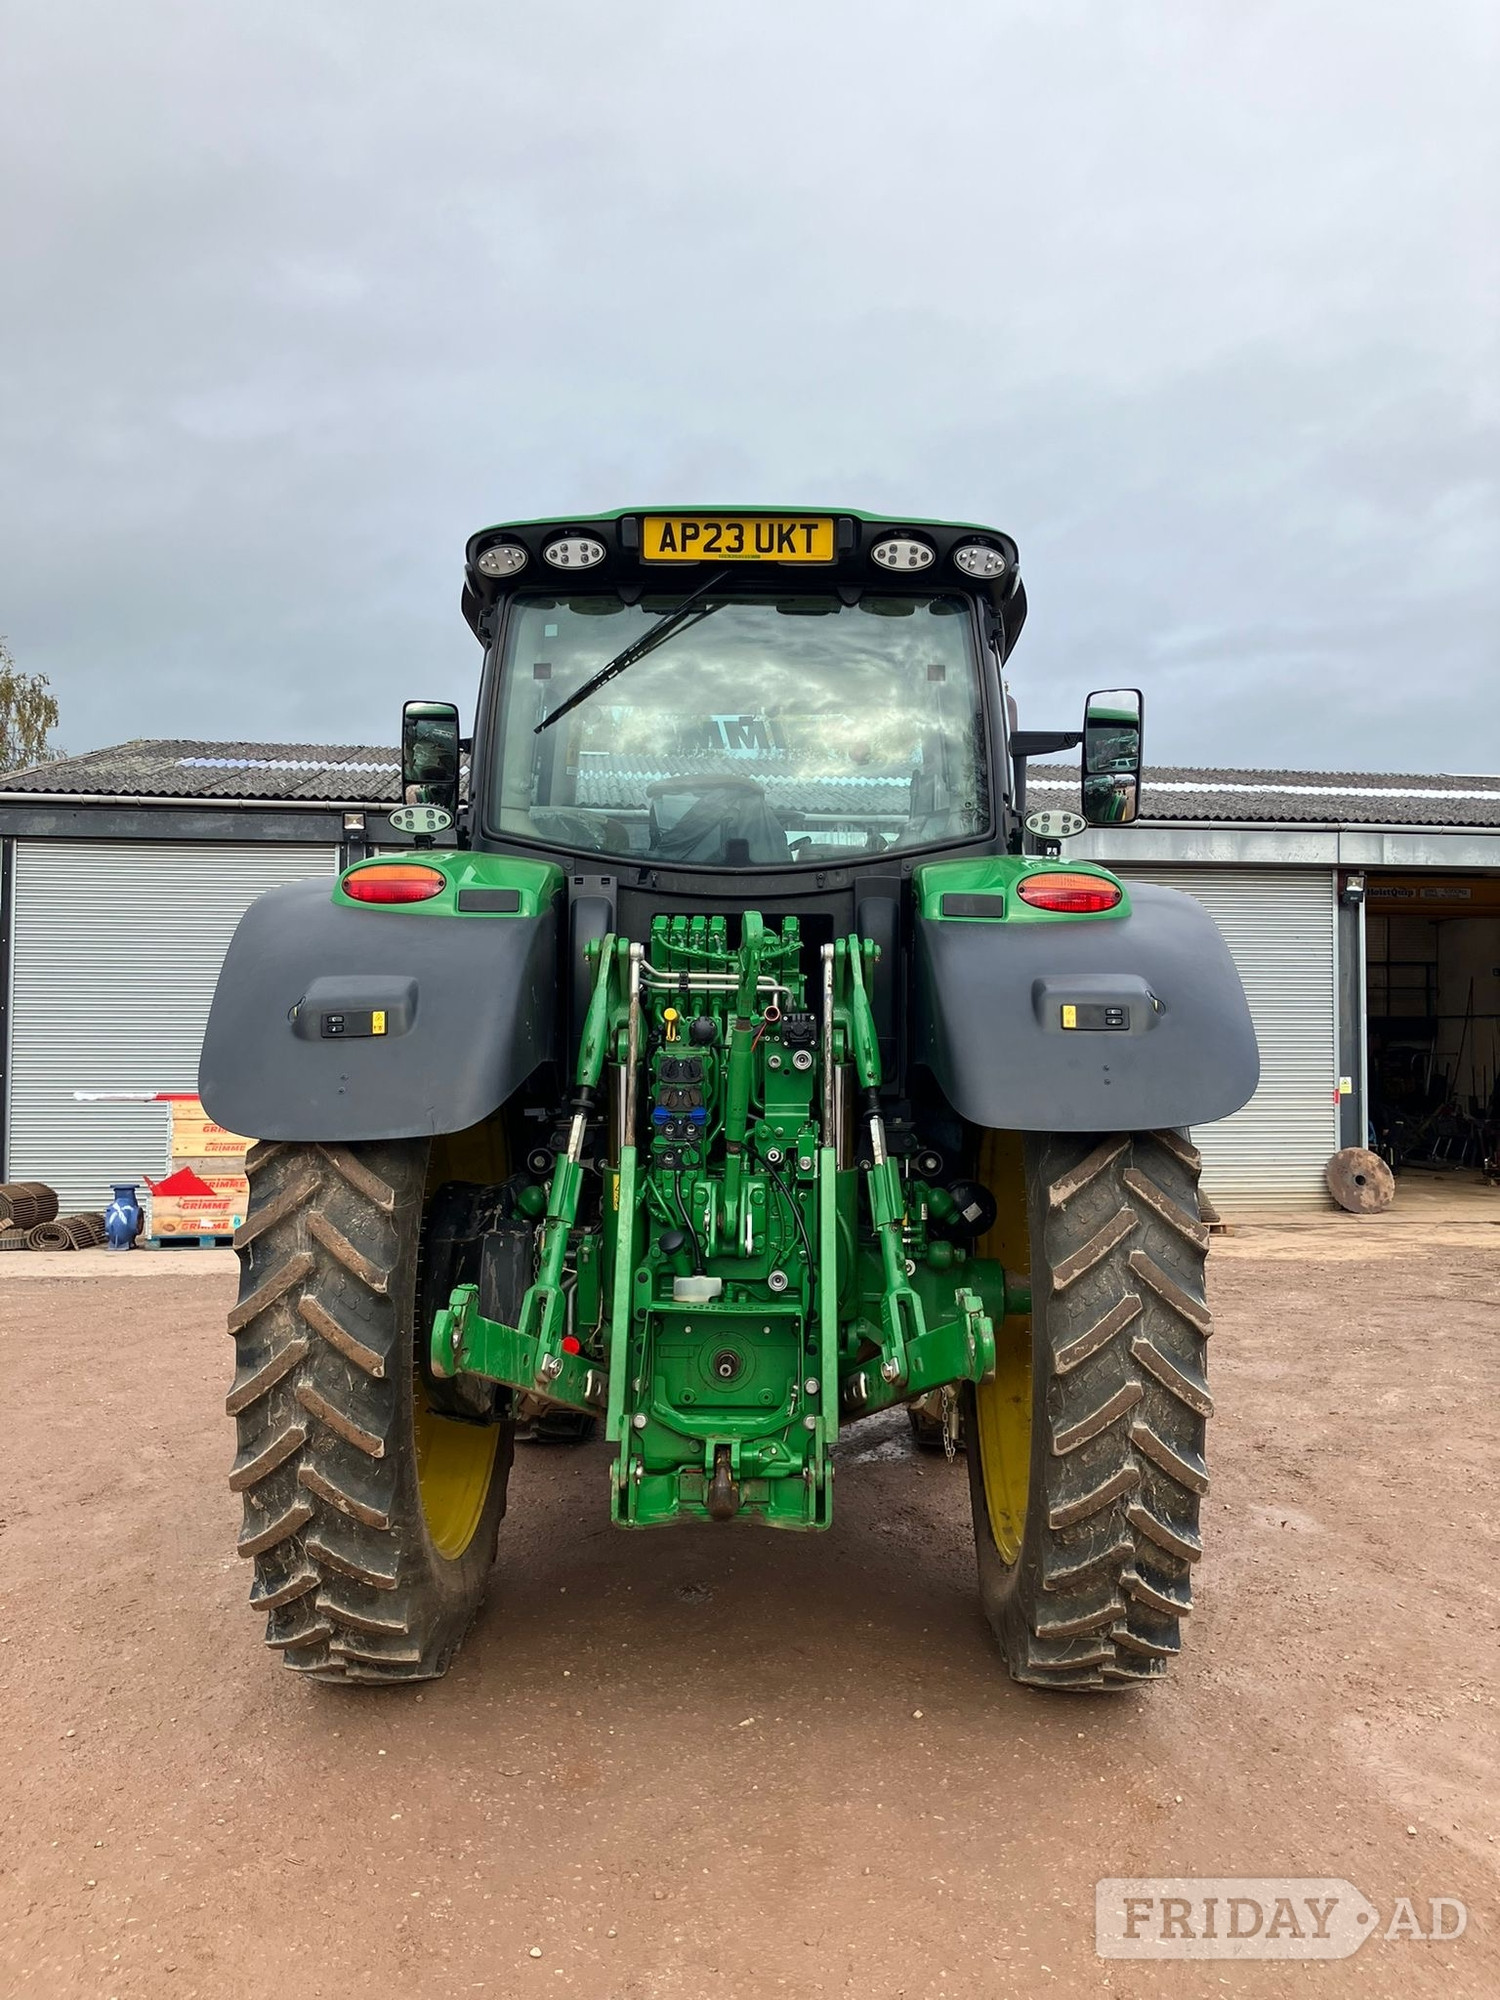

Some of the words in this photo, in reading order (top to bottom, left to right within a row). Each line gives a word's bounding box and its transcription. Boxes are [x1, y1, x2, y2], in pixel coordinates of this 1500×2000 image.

[658, 522, 744, 553] AP23
[755, 523, 818, 553] UKT
[204, 1144, 246, 1152] GRIMME
[205, 1180, 247, 1188] RIMME
[182, 1201, 230, 1209] GRIMME
[181, 1221, 229, 1230] GRIME
